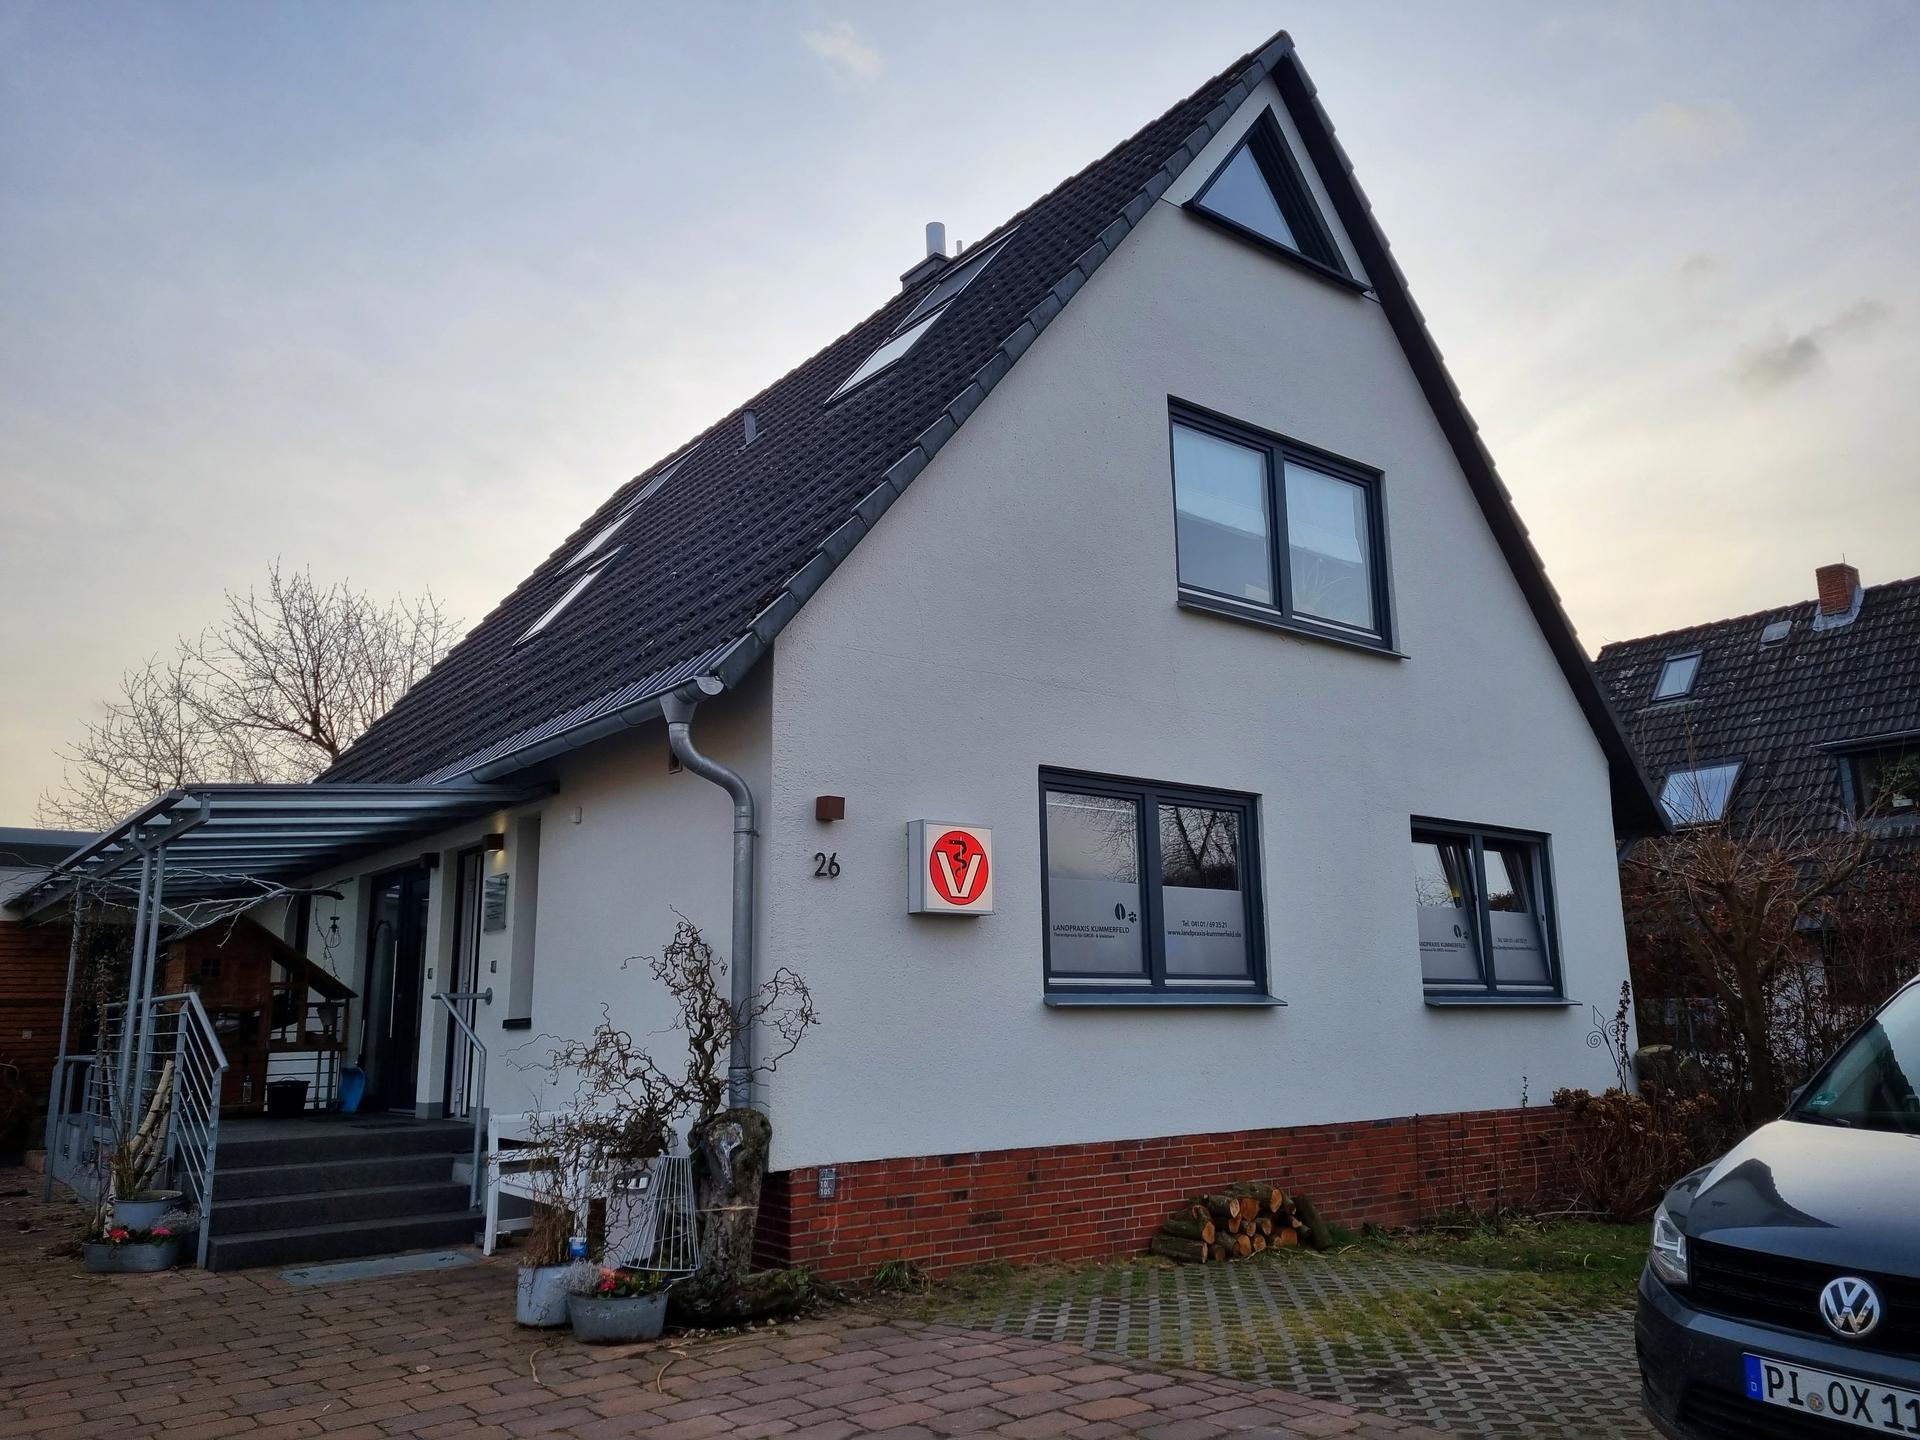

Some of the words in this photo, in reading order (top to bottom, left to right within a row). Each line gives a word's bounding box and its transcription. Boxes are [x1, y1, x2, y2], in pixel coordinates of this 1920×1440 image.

[814, 852, 841, 879] 26
[935, 850, 983, 899] V
[1052, 924, 1090, 932] LANDPRAXIS
[1090, 925, 1130, 934] KUMMERFELD
[1764, 1364, 1804, 1406] PI
[1827, 1380, 1873, 1423] OX
[1881, 1393, 1920, 1435] 11
